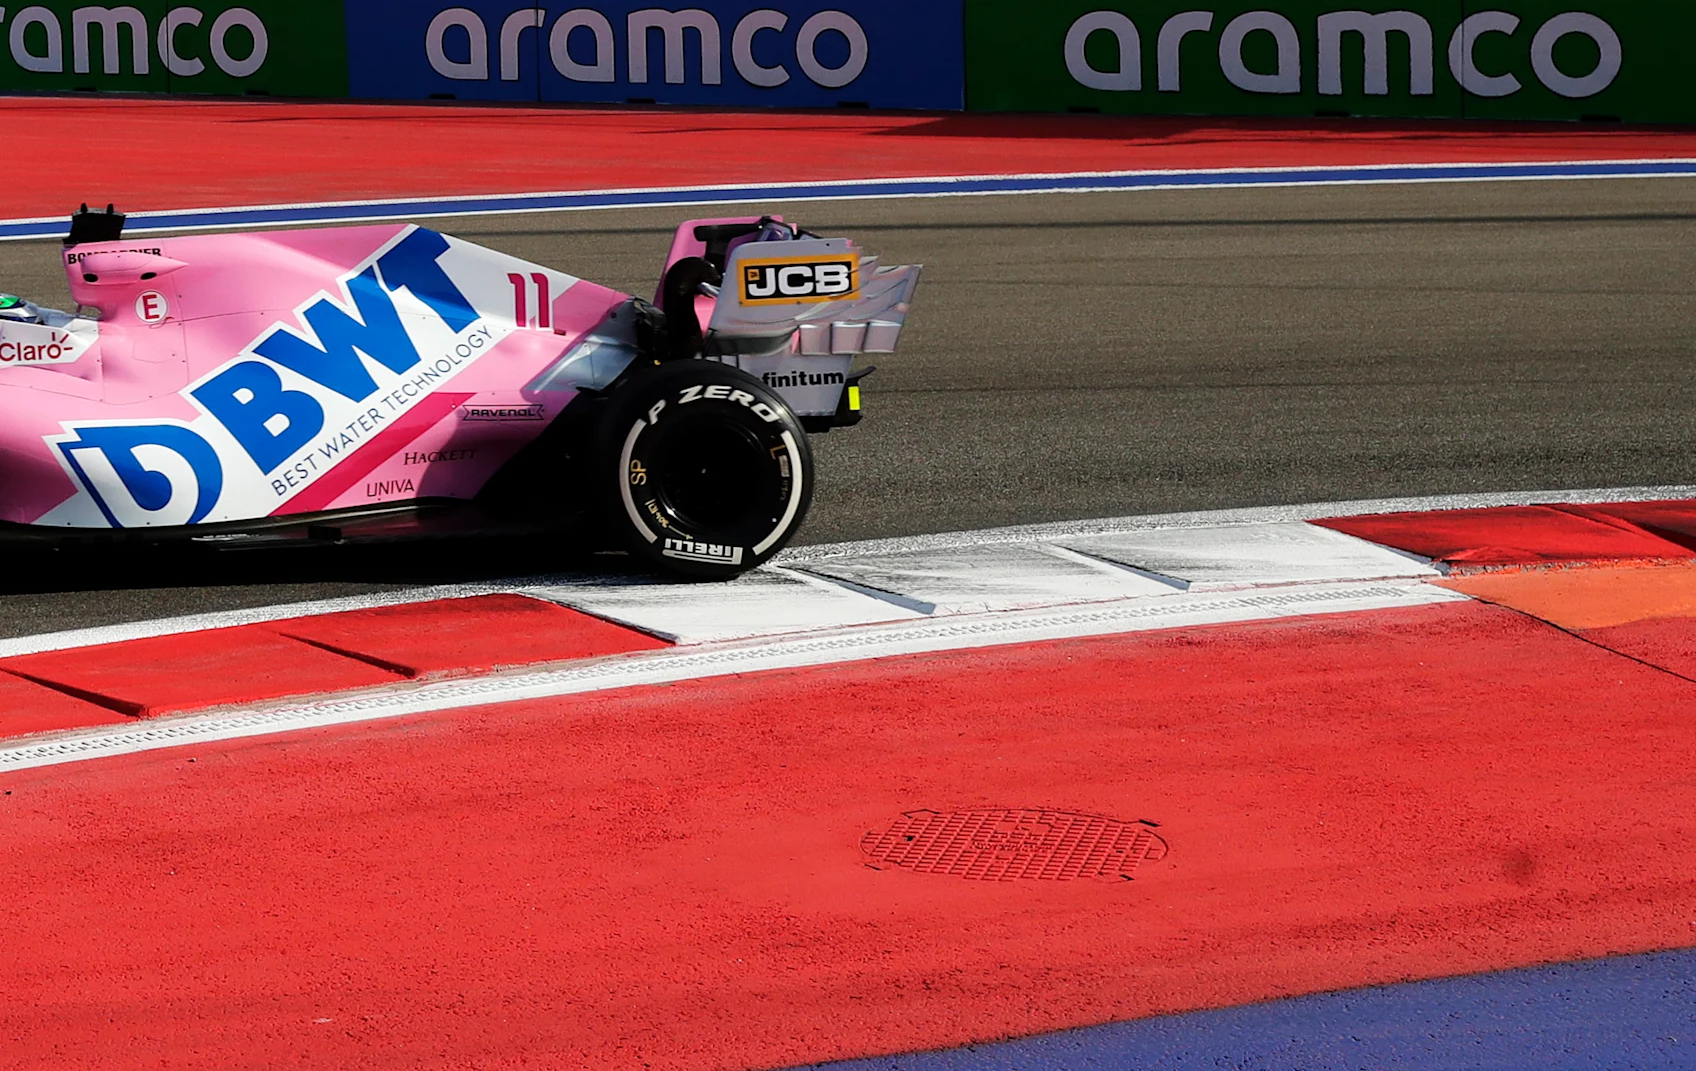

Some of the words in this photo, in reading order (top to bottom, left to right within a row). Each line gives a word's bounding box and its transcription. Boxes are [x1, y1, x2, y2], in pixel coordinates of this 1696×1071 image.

[425, 7, 869, 88] aramco
[1063, 10, 1622, 98] aramco
[747, 264, 850, 297] JCB
[142, 294, 160, 320] E
[507, 272, 550, 328] 11
[272, 454, 318, 497] BEST
[318, 407, 385, 461] WATER
[381, 325, 493, 411] TECHNOLOGY
[470, 408, 537, 418] RAVENOL
[648, 399, 667, 425] P
[678, 385, 782, 423] ZERO
[403, 448, 477, 466] HACKETT
[366, 478, 415, 497] UNIVA
[662, 538, 743, 565] PIRELLI
